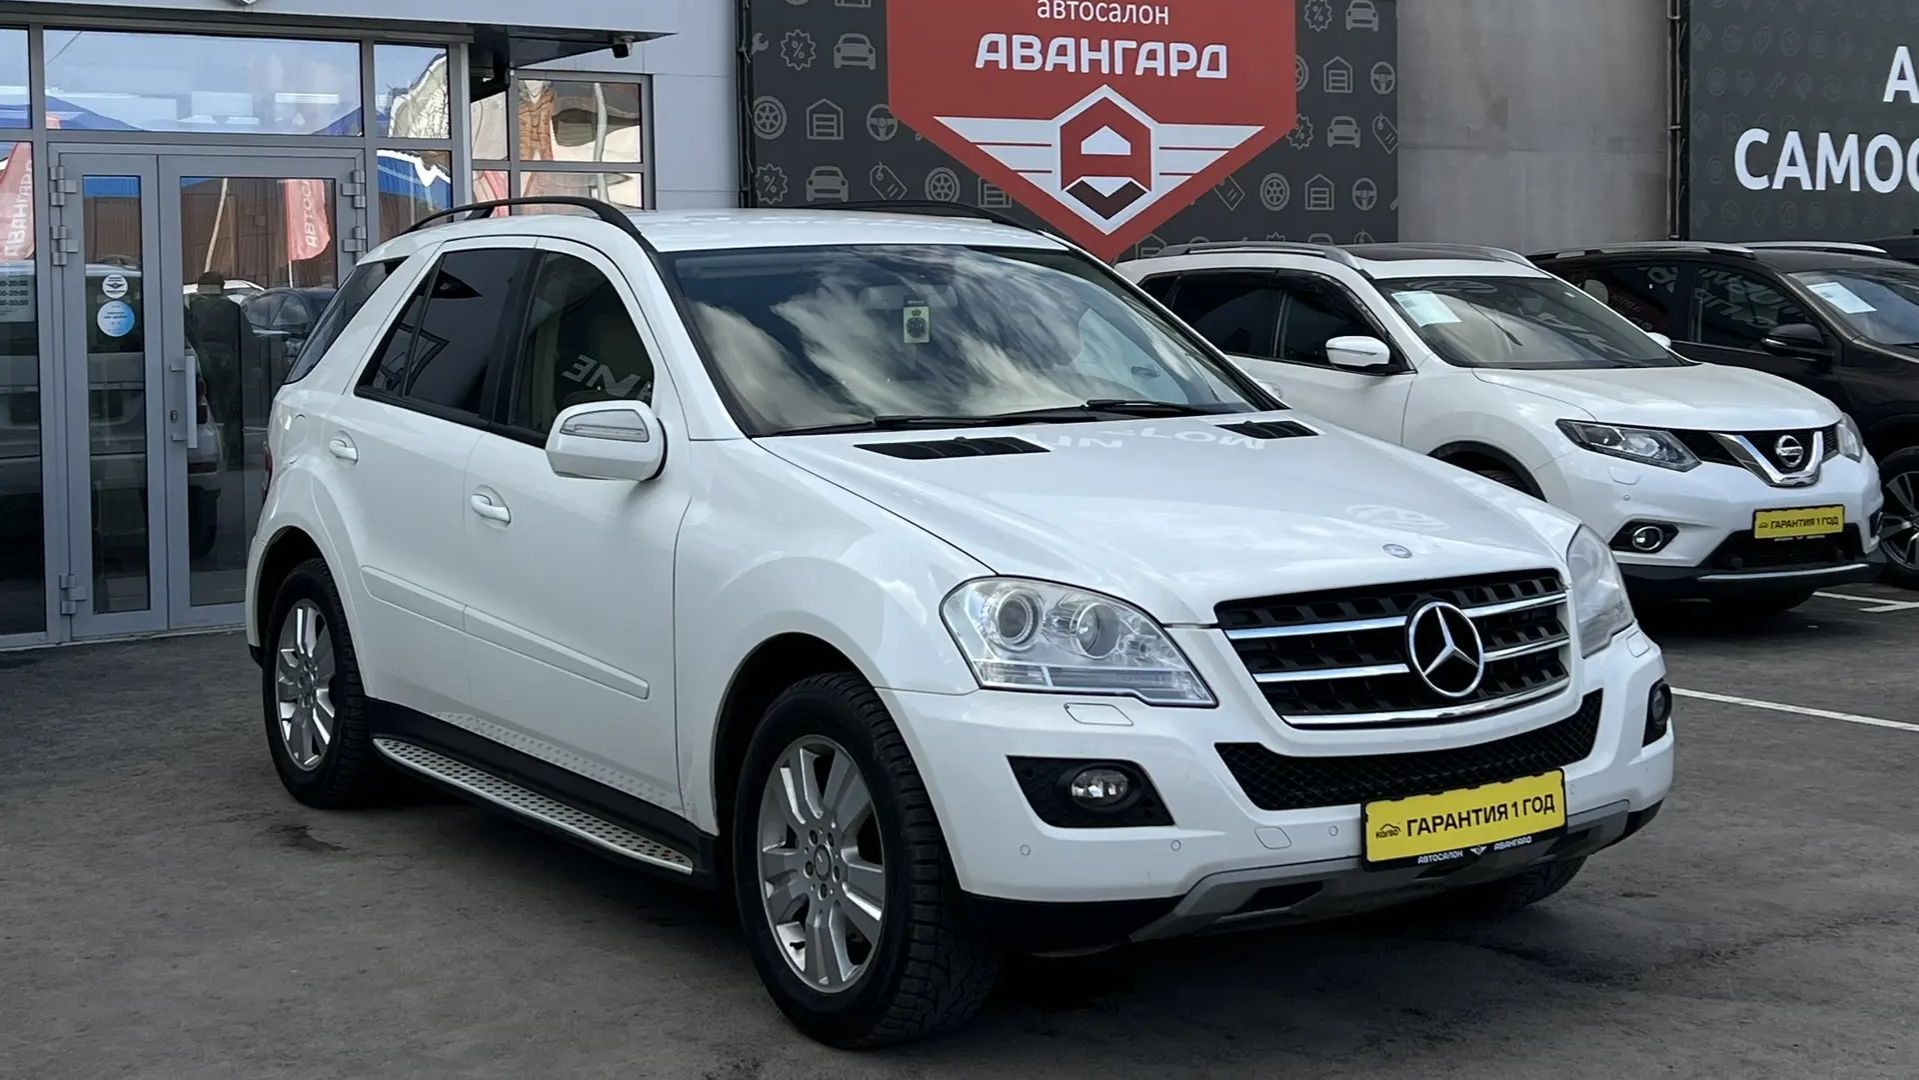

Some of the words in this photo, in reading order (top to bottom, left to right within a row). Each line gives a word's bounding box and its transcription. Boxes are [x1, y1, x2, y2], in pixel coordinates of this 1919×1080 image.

[1037, 0, 1169, 25] автосалон
[975, 33, 1228, 79] АВАНГАРД
[1770, 517, 1815, 529] ГАРАНТИЯ
[1821, 516, 1839, 526] ГОД
[1406, 803, 1509, 837] ГАРАНТИЯ
[1511, 801, 1519, 818] 1
[1522, 794, 1556, 816] ГОД
